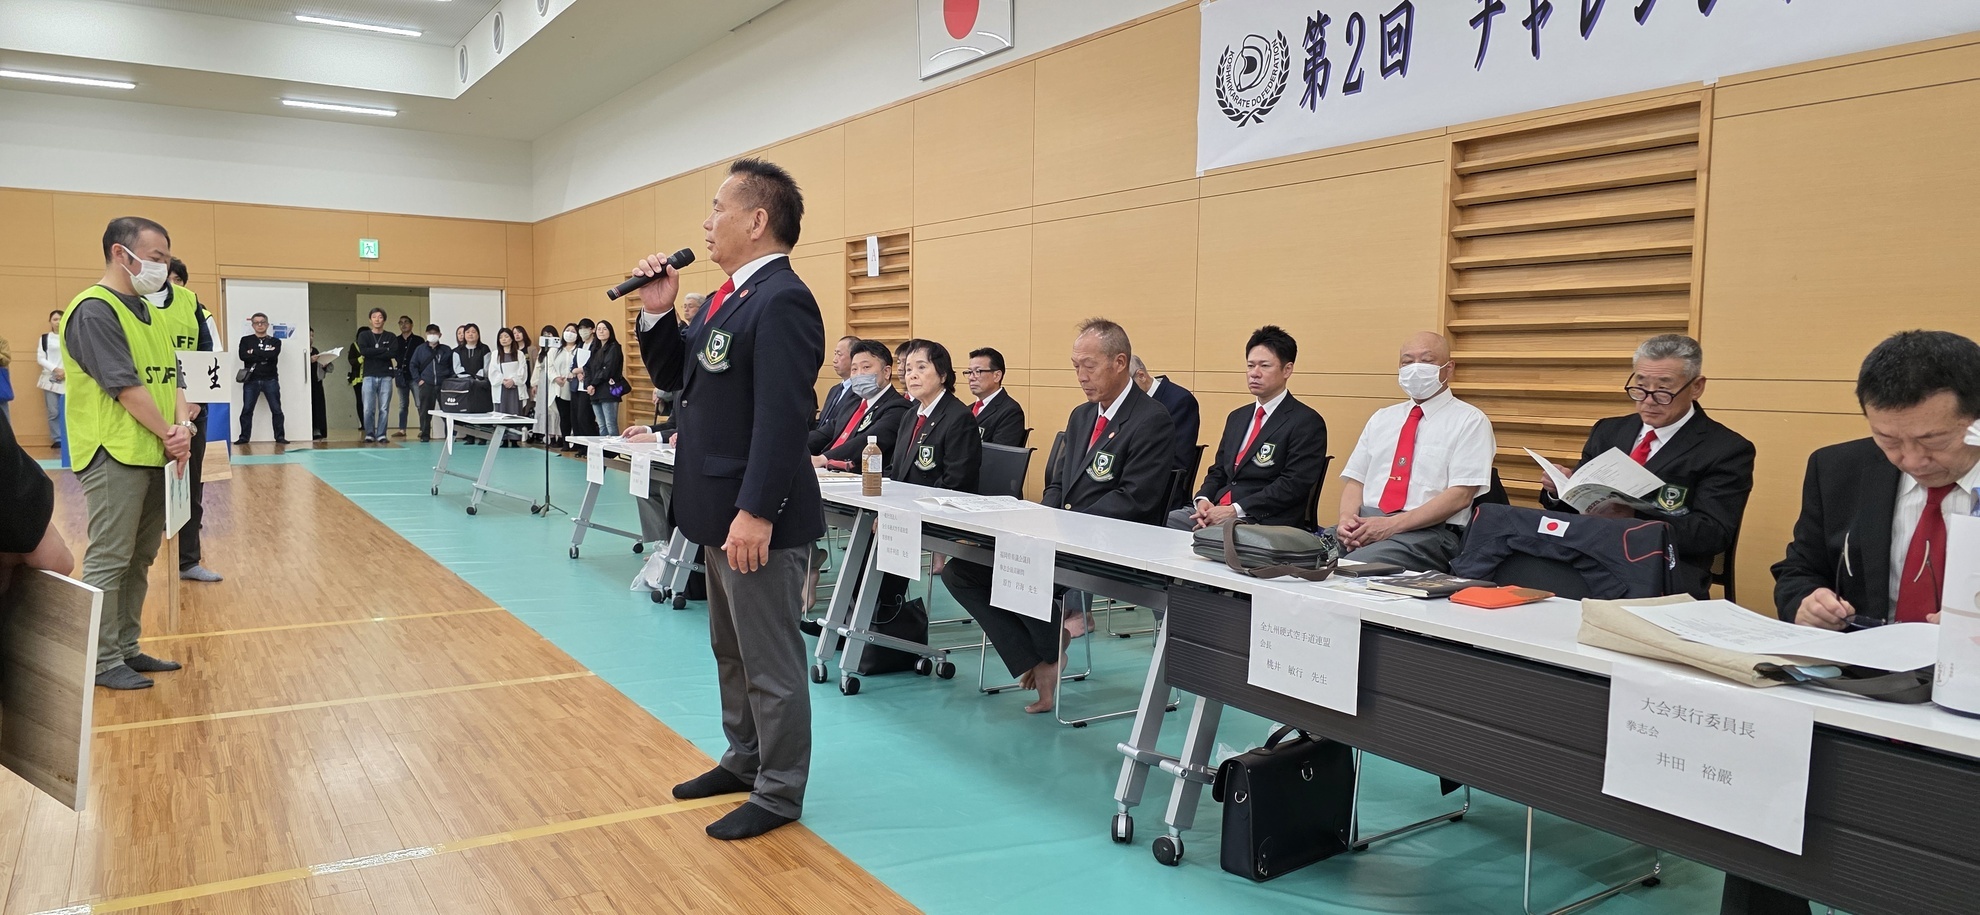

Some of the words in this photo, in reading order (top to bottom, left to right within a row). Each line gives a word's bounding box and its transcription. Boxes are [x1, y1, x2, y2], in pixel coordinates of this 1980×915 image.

[1299, 0, 1415, 113] 第2回
[1260, 621, 1331, 648] 全九州硬式空手道連盟
[1260, 639, 1272, 650] 会長
[1266, 658, 1281, 672] 桃井
[1288, 664, 1304, 679] 敏行
[1311, 671, 1328, 685] 先生
[1626, 719, 1660, 739] 拳志会
[1641, 697, 1756, 739] 大会実行委員長
[1656, 751, 1686, 772] 井田
